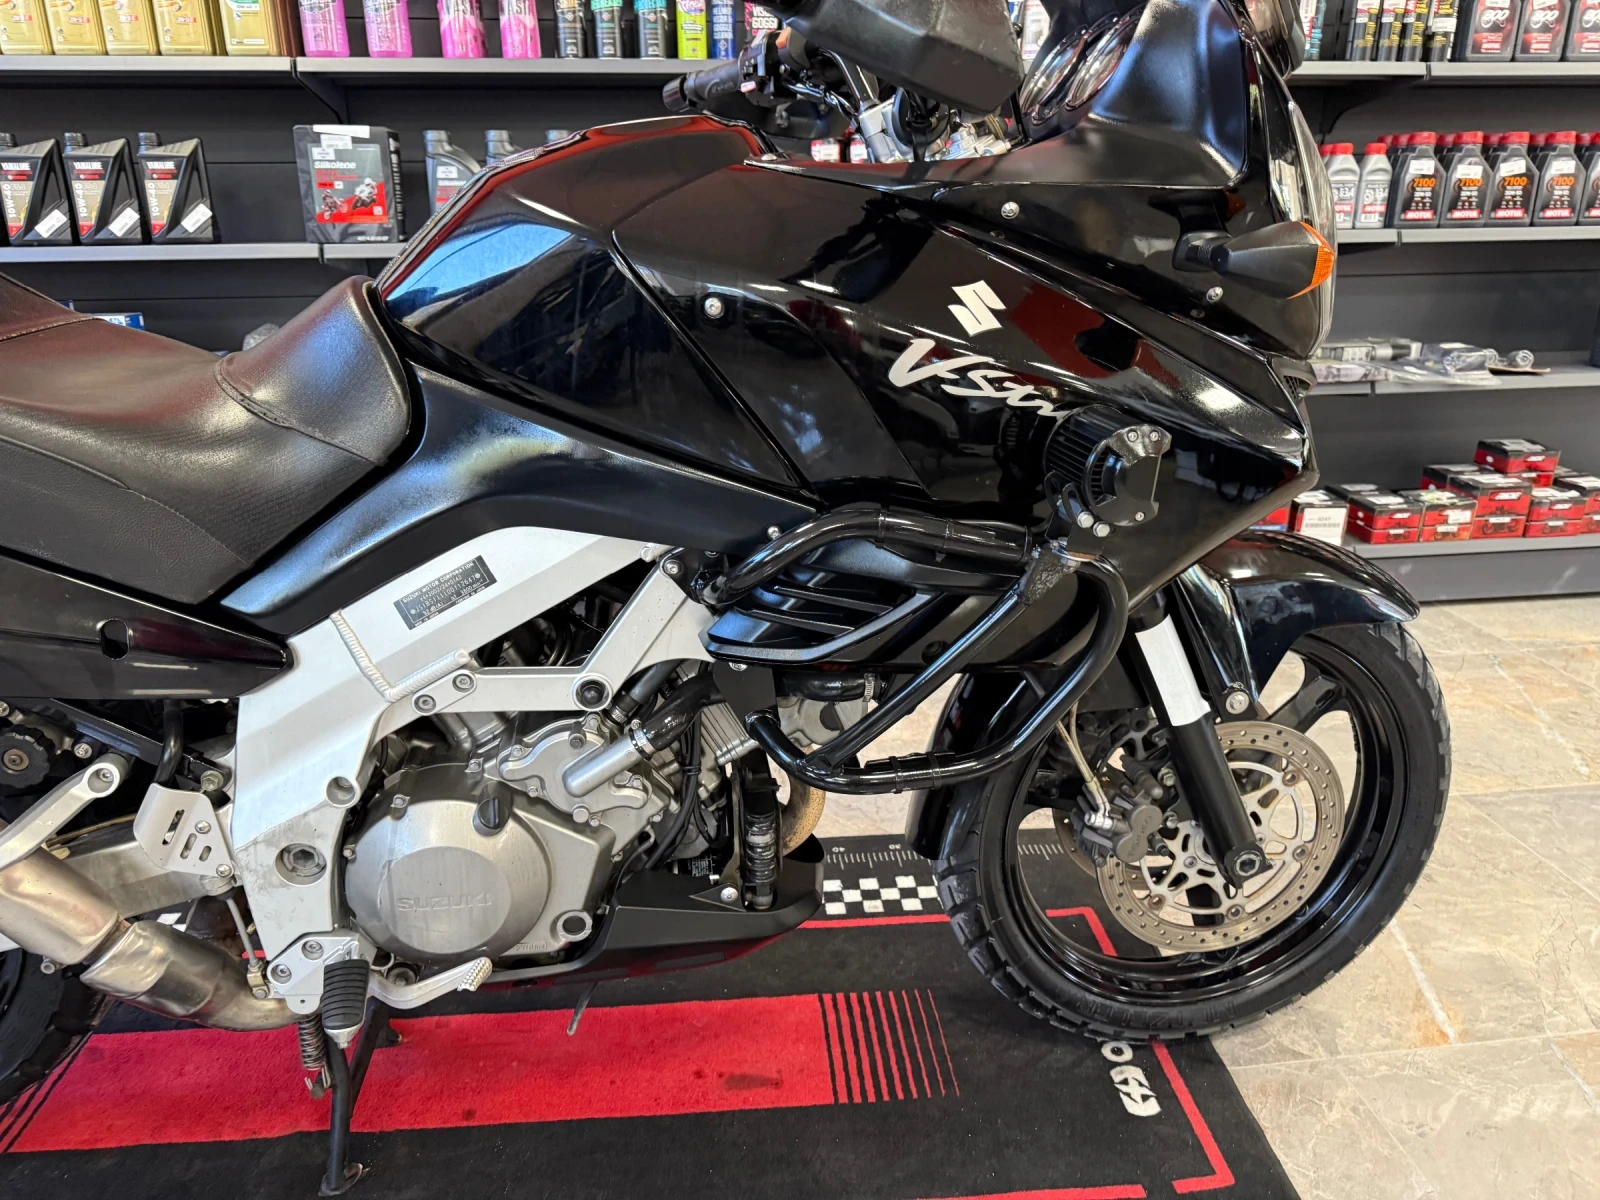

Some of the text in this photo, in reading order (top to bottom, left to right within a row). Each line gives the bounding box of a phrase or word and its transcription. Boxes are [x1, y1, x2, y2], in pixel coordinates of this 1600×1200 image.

[313, 160, 357, 169] Silkolene
[1413, 177, 1436, 188] 7100
[1460, 177, 1483, 188] 7100
[1503, 176, 1528, 186] 7100
[1552, 176, 1575, 186] 7100
[3, 183, 16, 218] 10W-40
[75, 183, 88, 217] 10W-40
[147, 182, 160, 217] 10W-40
[1406, 211, 1433, 219] MOTUL
[1452, 210, 1479, 219] MOTUL
[1496, 209, 1523, 218] MOTUL
[1543, 208, 1570, 218] MOTUL
[422, 580, 440, 593] MOTOR
[397, 892, 492, 911] SUZUKI
